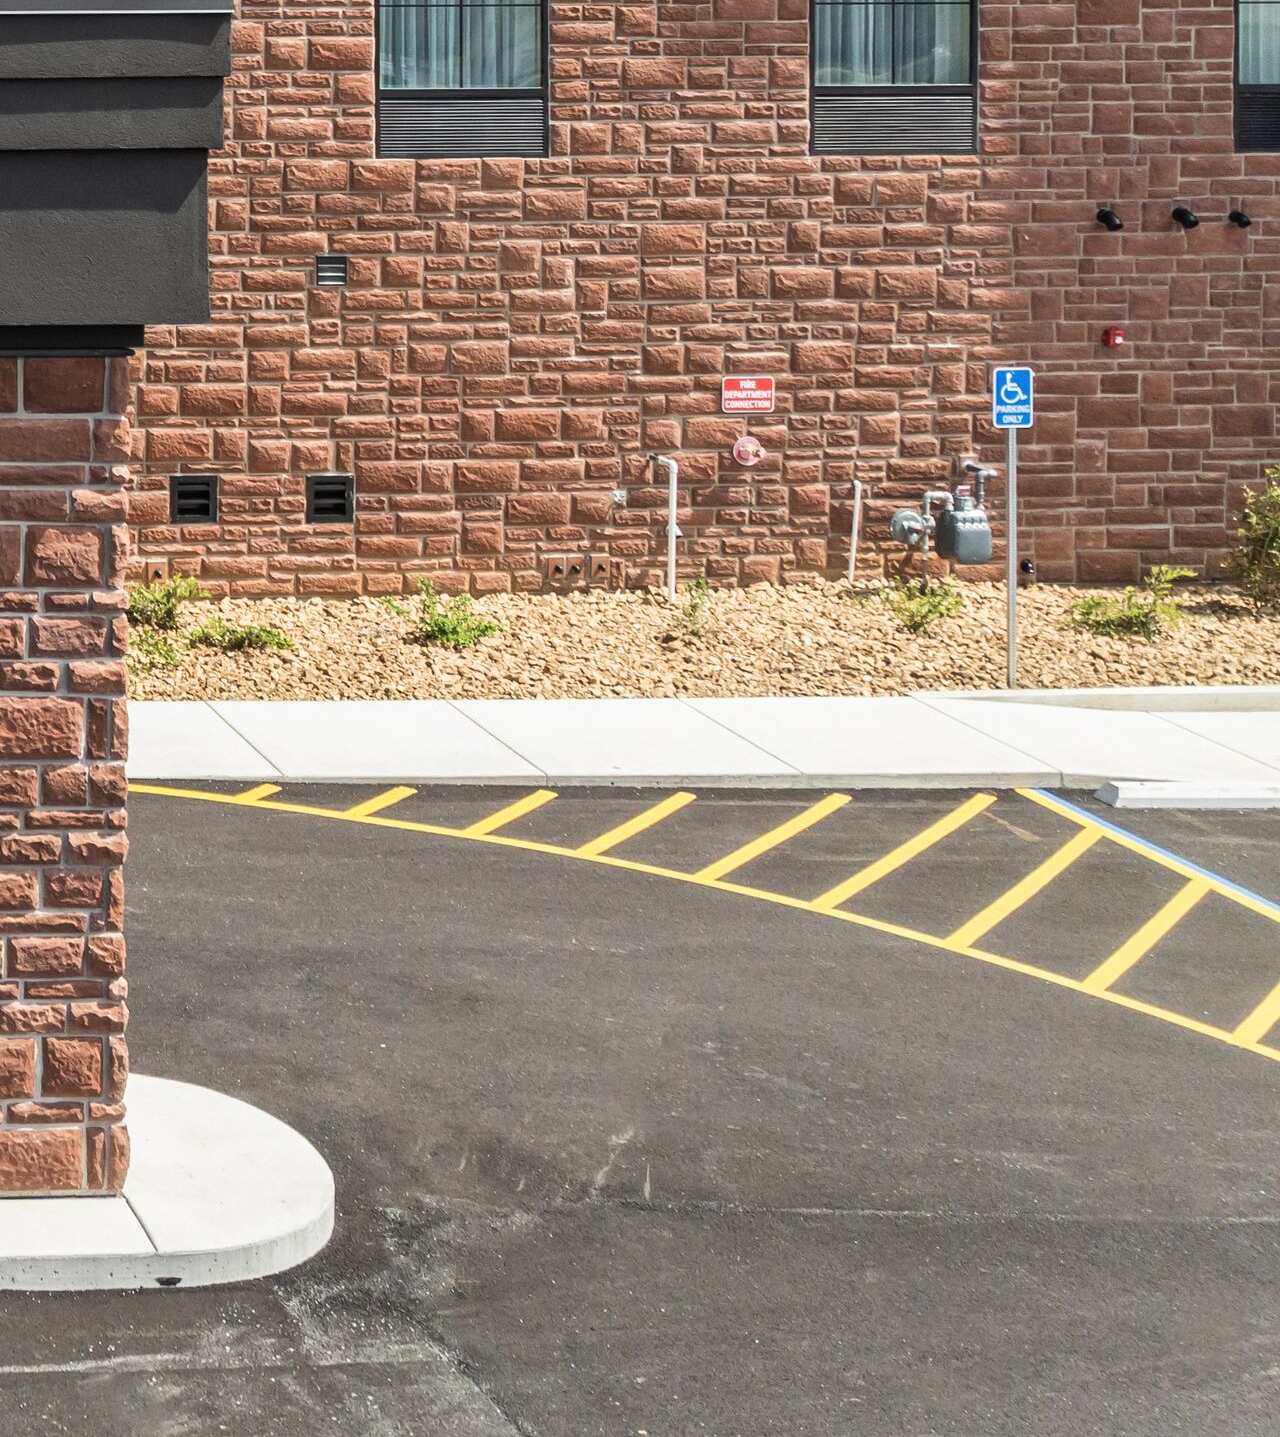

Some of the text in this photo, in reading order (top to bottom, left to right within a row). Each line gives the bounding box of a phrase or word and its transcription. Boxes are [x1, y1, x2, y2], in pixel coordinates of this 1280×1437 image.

[740, 380, 756, 389] FIRE
[724, 390, 771, 399] DEPARTMENT
[725, 400, 771, 409] CONNECTION
[996, 405, 1030, 413] PARKING
[1002, 415, 1023, 423] ONLY
